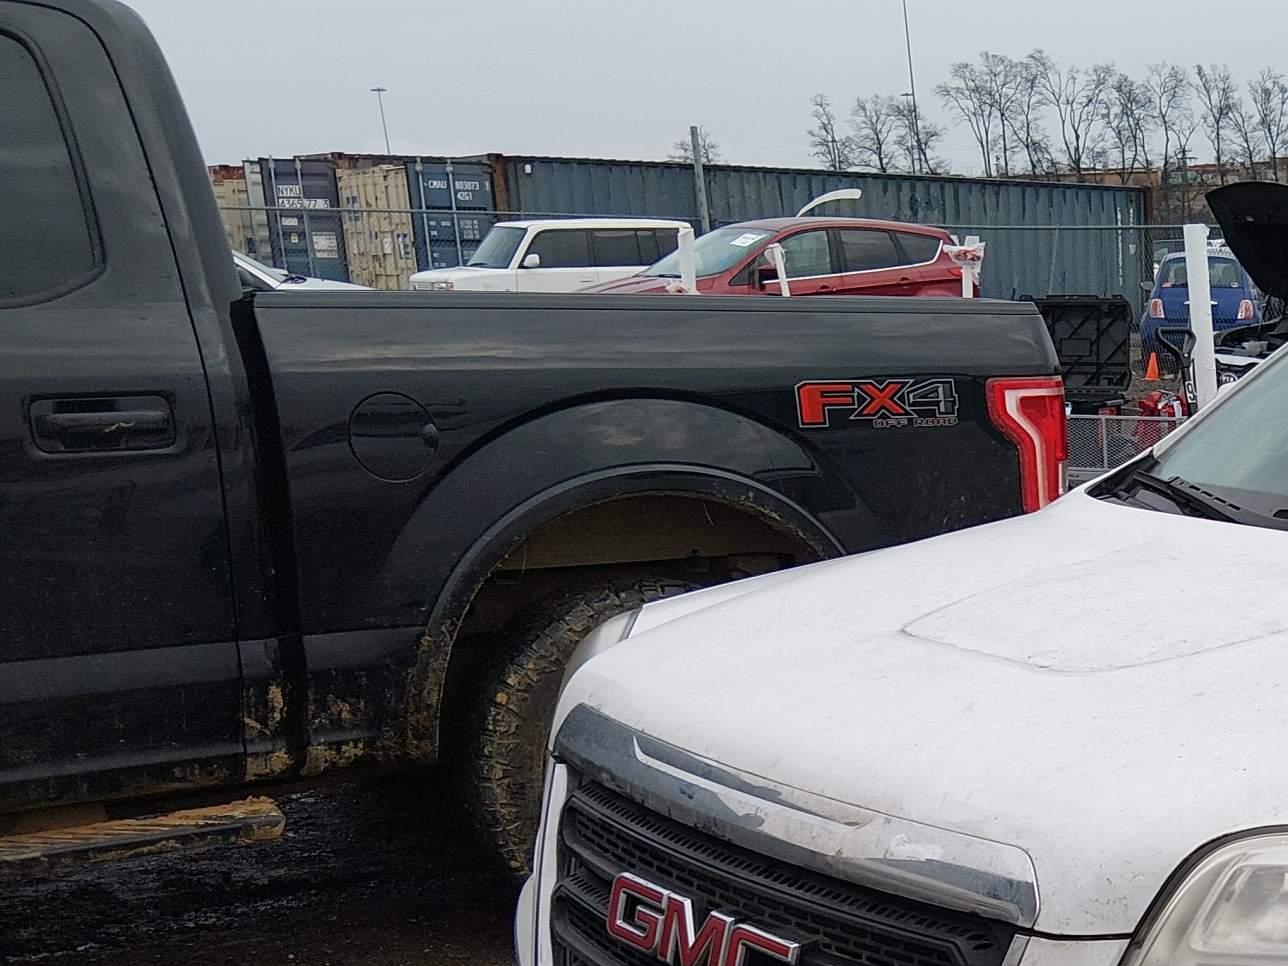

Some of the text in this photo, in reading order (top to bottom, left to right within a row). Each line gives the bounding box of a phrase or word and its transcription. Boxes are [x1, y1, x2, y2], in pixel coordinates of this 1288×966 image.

[278, 186, 300, 195] NYKU
[795, 378, 958, 428] FX4
[872, 417, 959, 428] OFF ROAD
